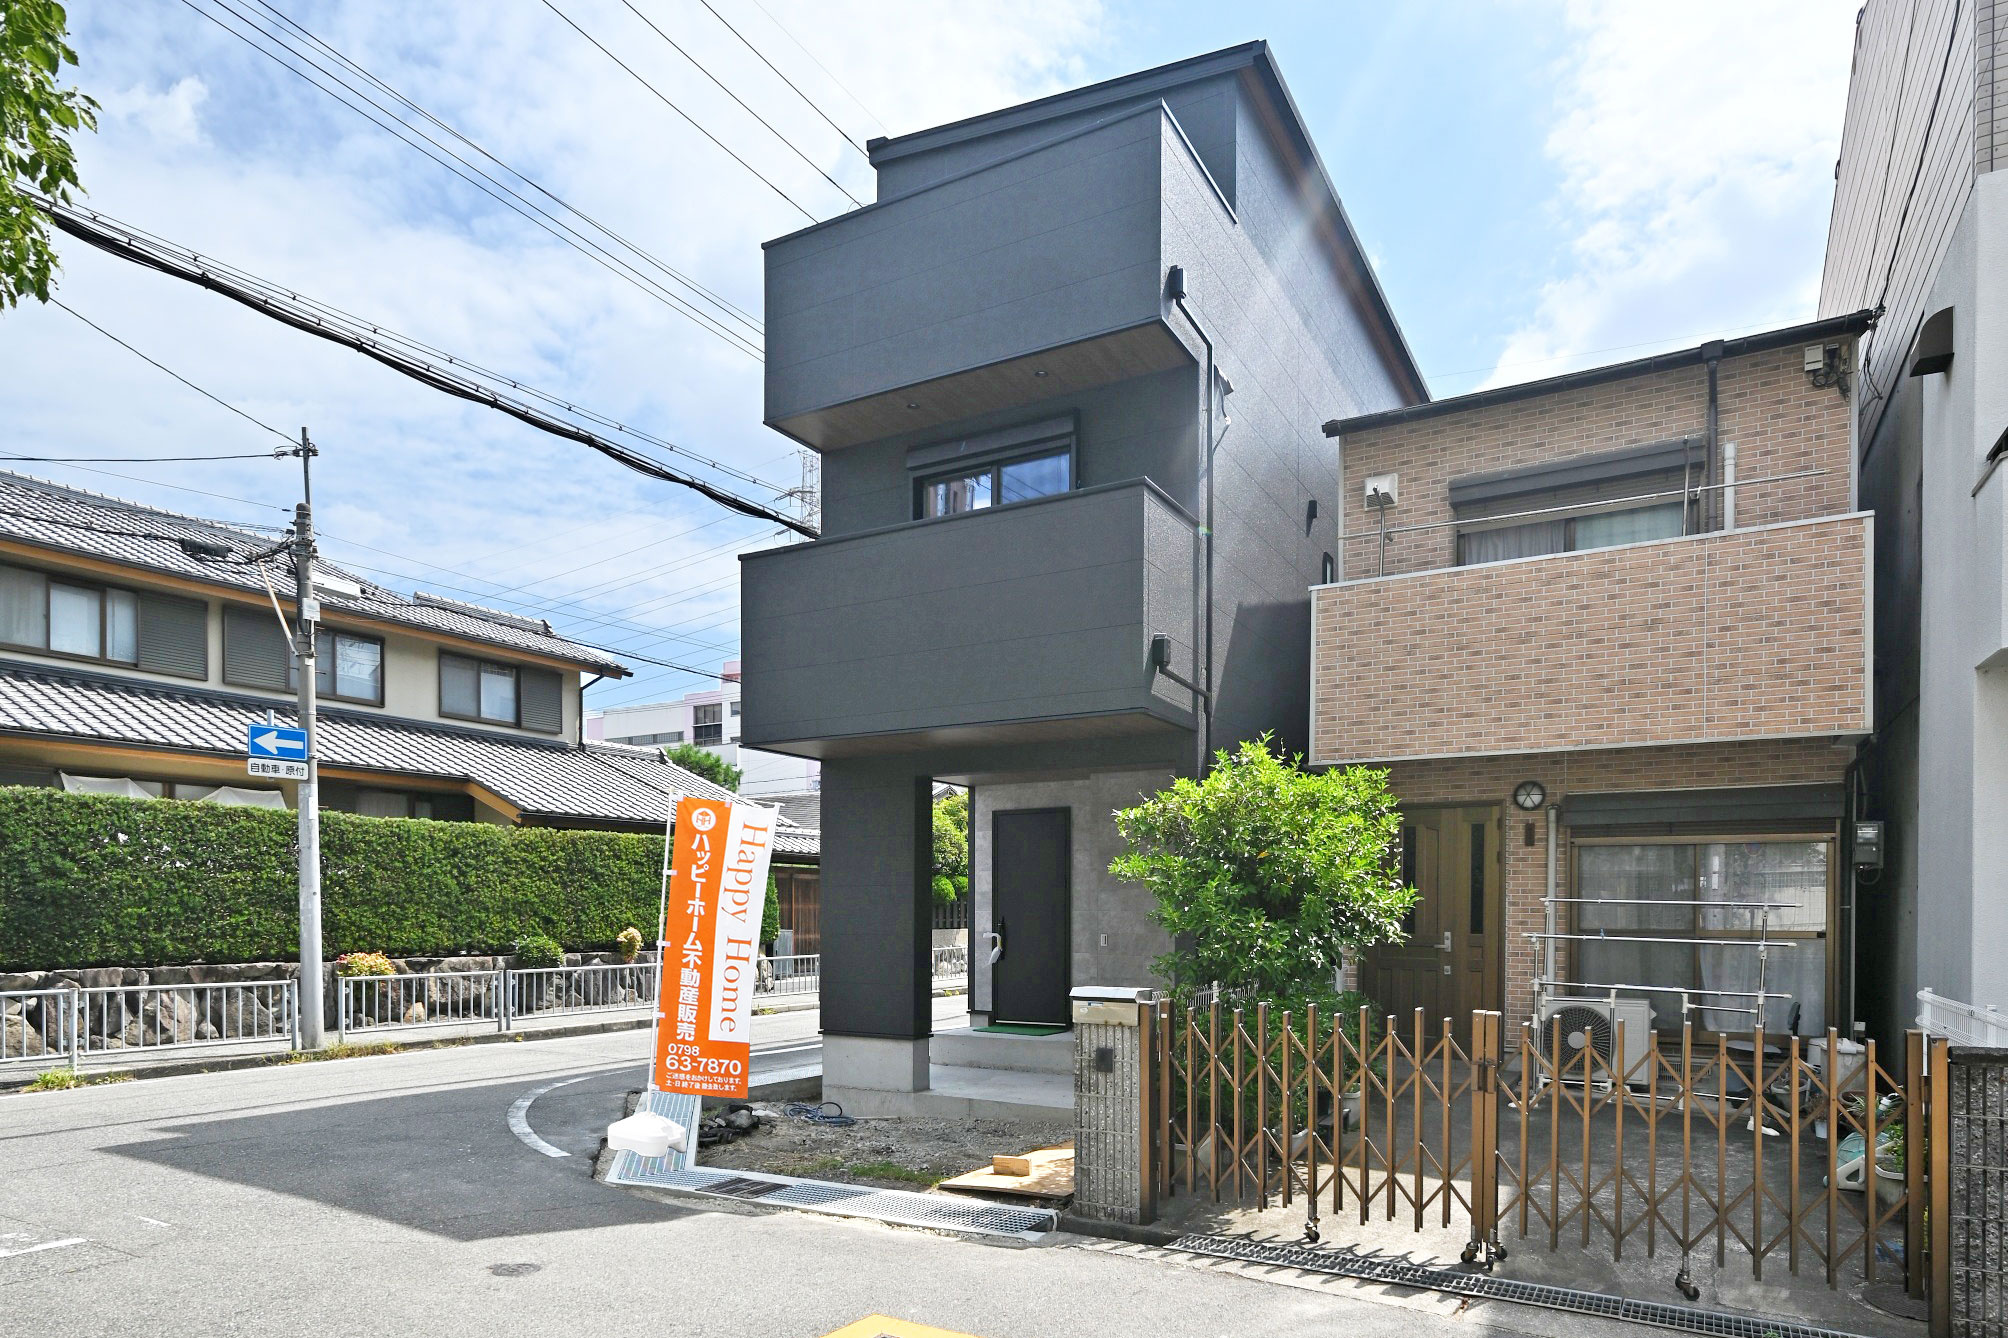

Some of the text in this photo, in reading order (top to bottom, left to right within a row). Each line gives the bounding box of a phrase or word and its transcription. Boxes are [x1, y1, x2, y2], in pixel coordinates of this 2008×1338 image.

[676, 833, 710, 1041] ハッピーホーム不動産販売
[719, 821, 768, 1034] Happy Home
[665, 1055, 742, 1075] 63-7870
[668, 1043, 700, 1056] 0798
